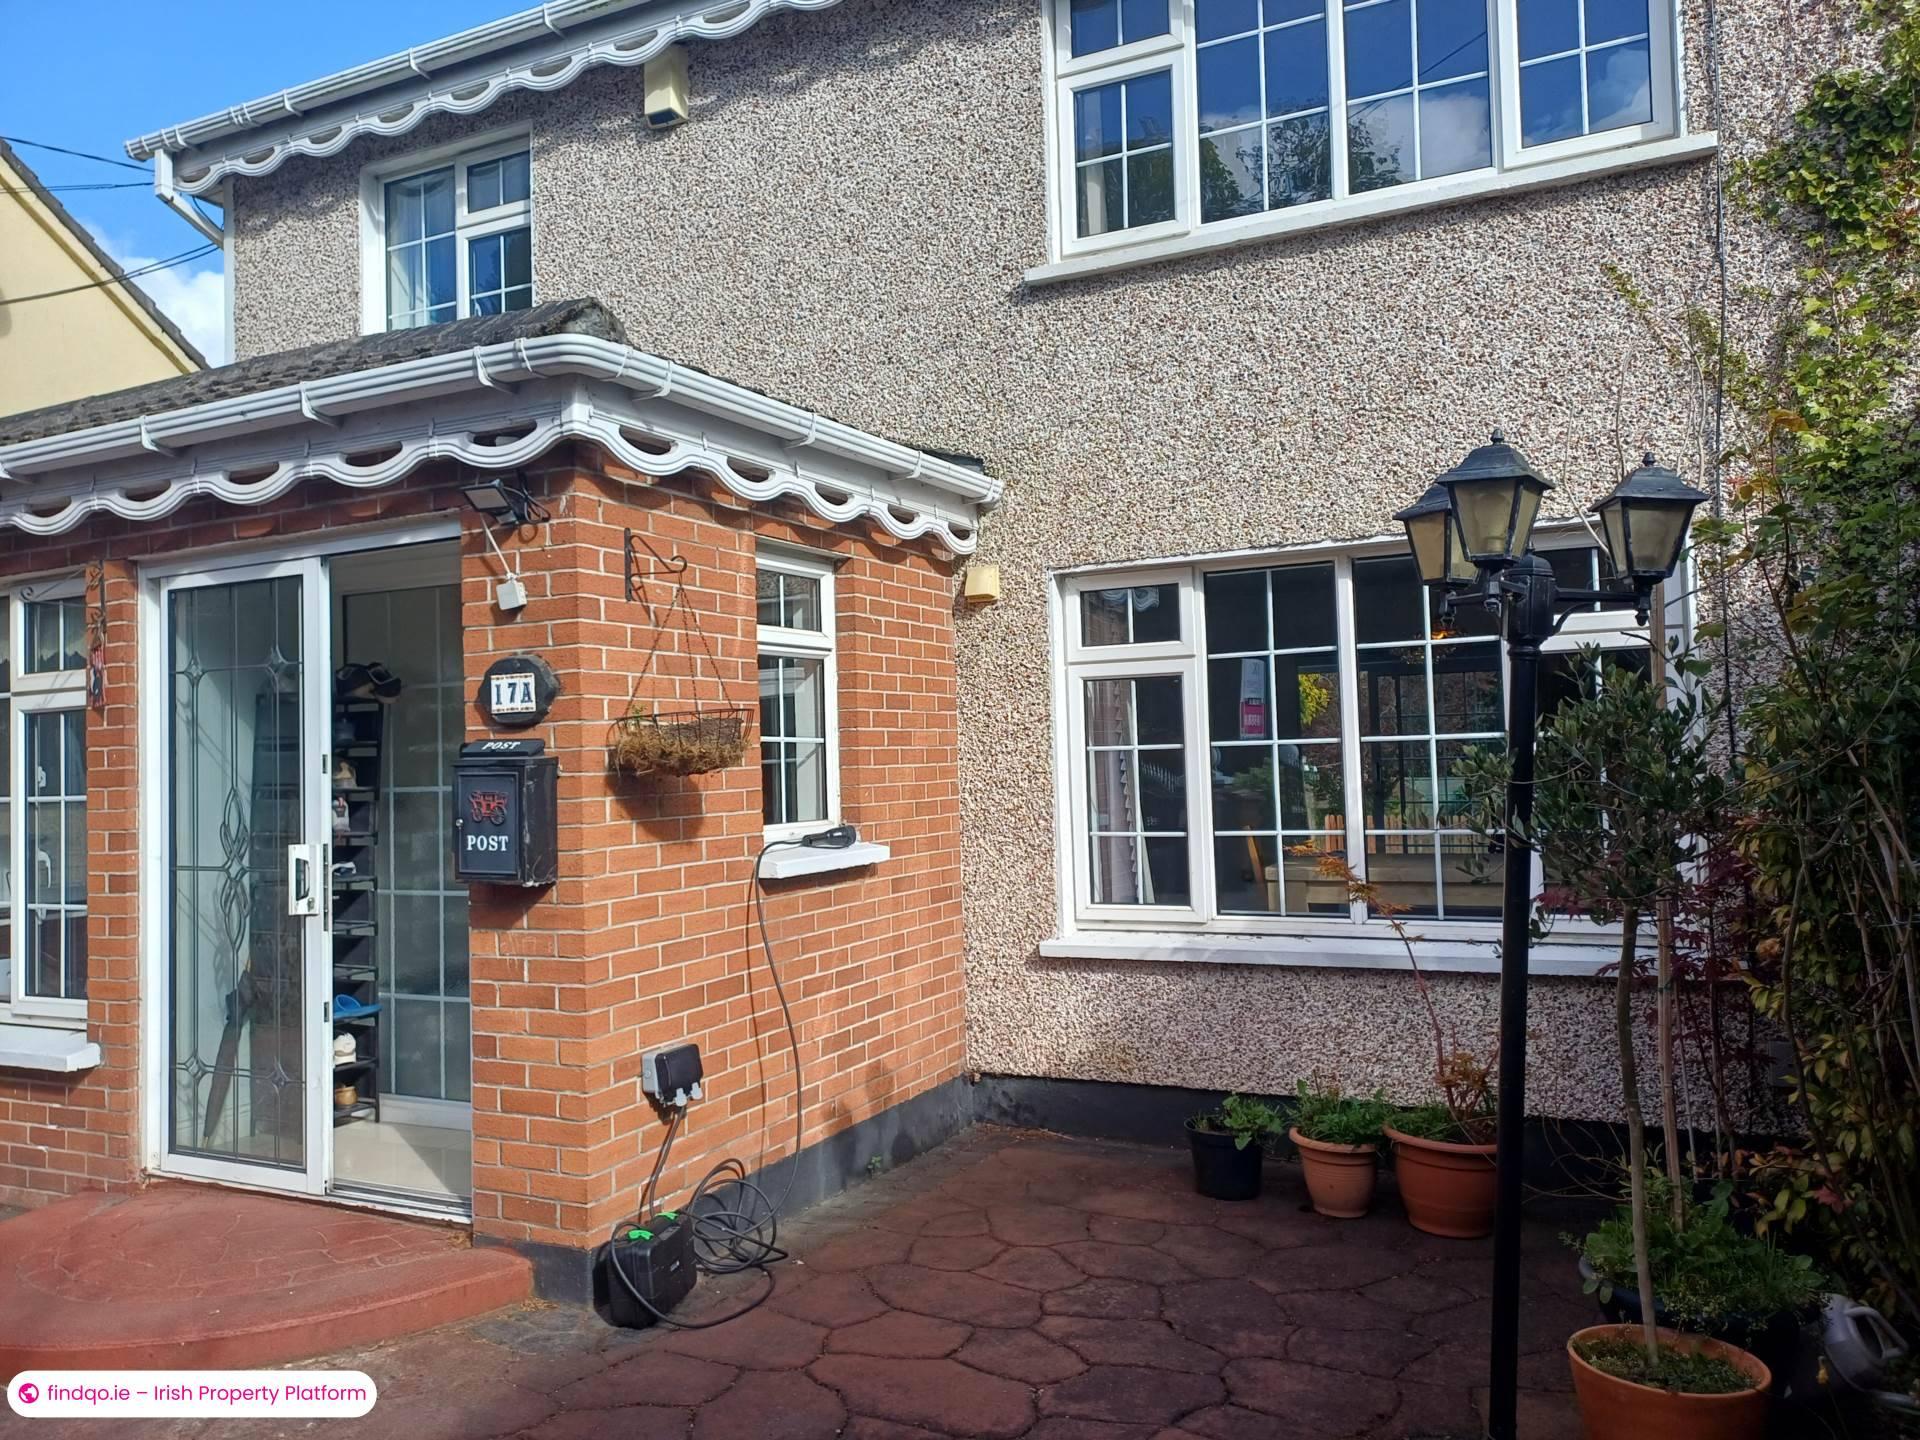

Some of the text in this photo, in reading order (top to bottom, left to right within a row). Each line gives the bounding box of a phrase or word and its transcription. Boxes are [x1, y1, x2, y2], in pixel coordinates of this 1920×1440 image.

[495, 681, 534, 706] 17A
[481, 741, 521, 750] POST
[466, 834, 509, 852] POST
